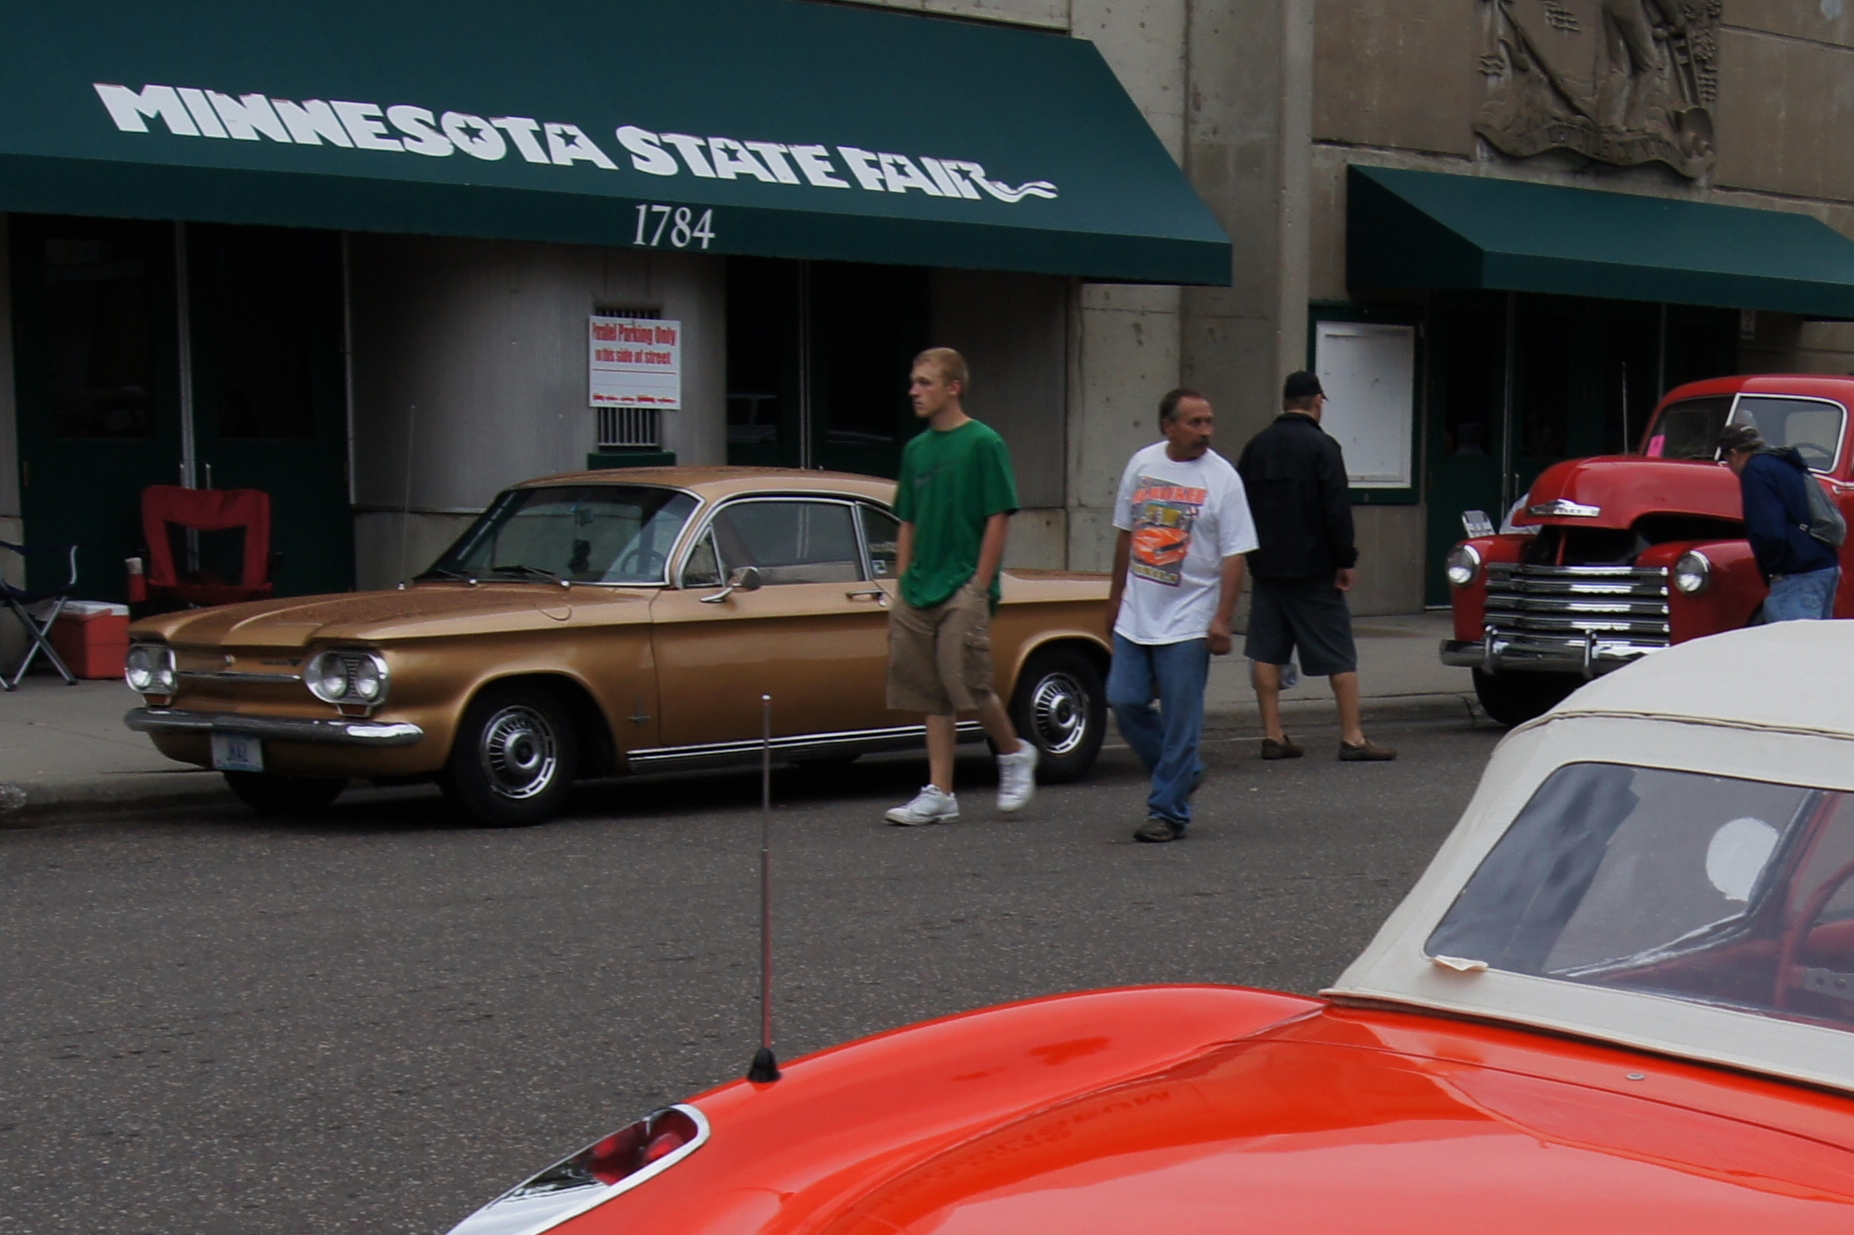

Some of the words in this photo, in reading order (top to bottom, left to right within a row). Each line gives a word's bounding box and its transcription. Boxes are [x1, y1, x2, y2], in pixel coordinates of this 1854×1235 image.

[93, 82, 619, 171] MINNESOTA
[615, 125, 850, 189] STATE
[837, 145, 1058, 203] FAIR
[632, 203, 716, 250] 1784
[618, 322, 653, 345] Parking
[656, 325, 677, 346] Only
[616, 347, 633, 363] side
[645, 349, 671, 364] street
